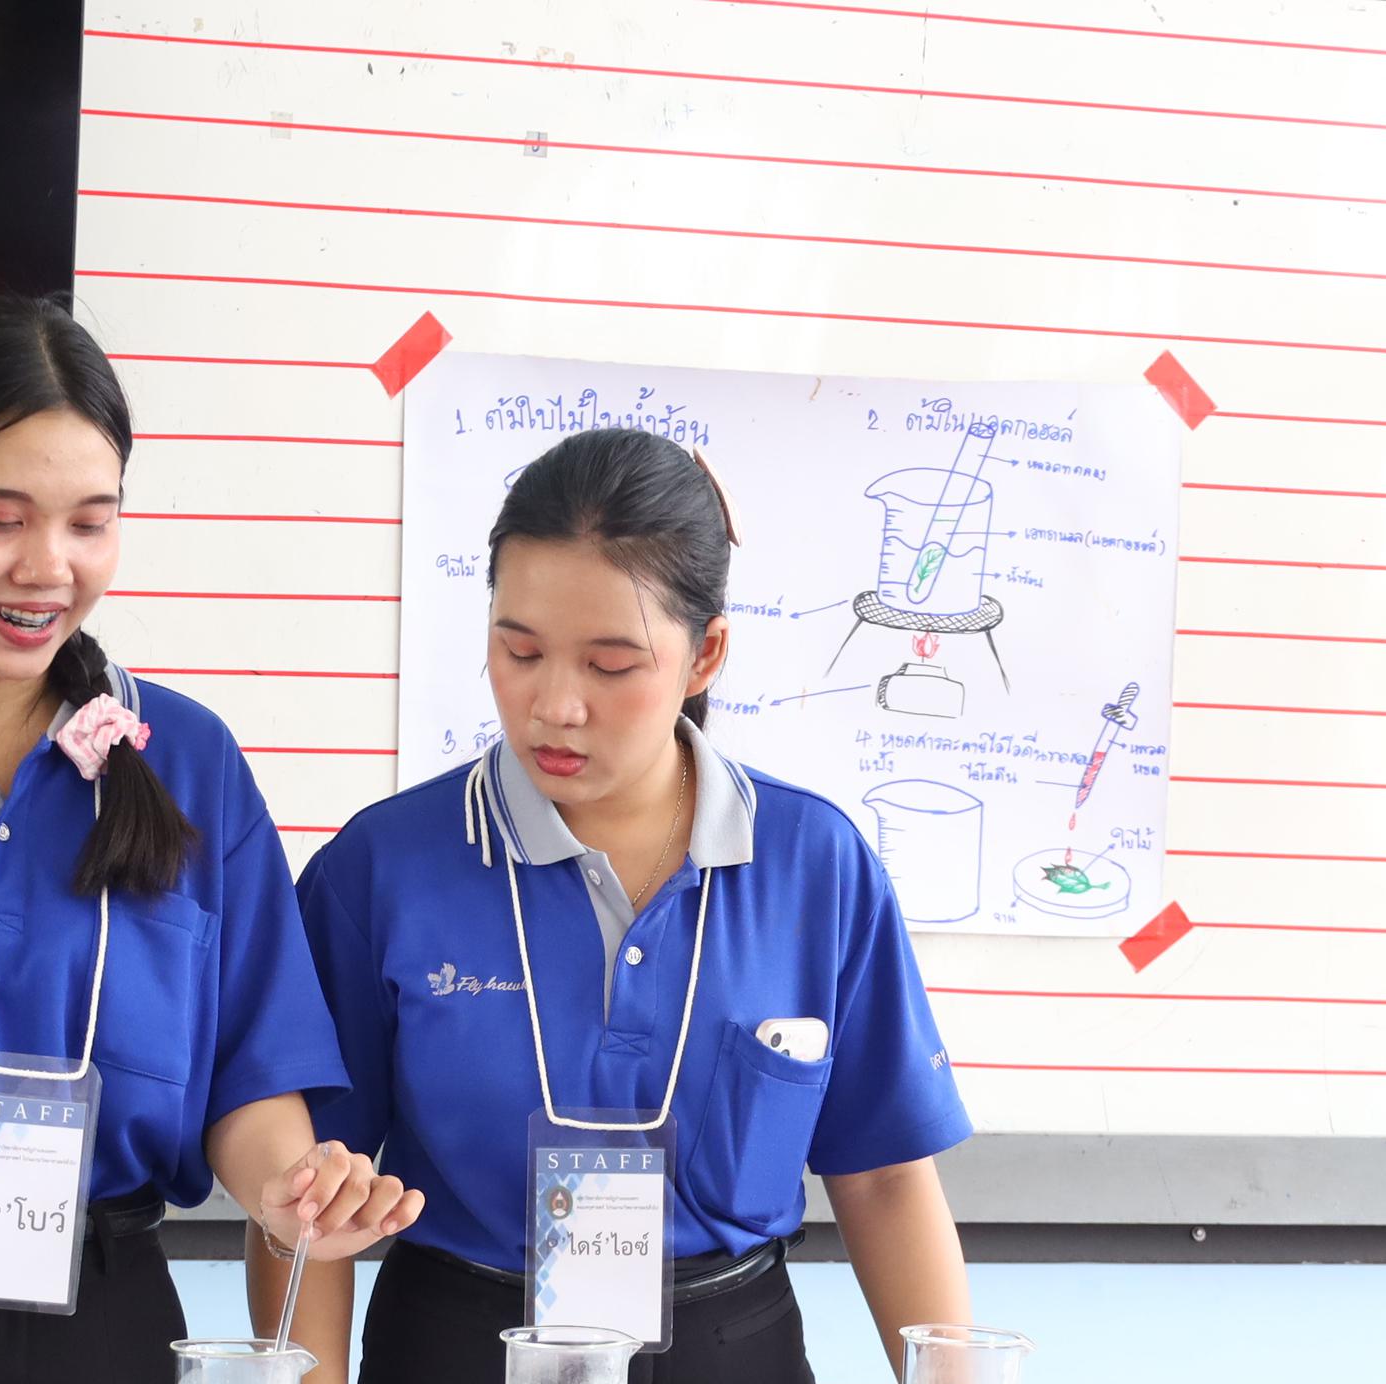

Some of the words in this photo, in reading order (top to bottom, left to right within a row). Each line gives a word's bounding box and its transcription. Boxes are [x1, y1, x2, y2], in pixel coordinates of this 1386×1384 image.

[435, 553, 480, 578] ใบไม้
[1110, 827, 1156, 851] ใบไม้
[547, 1152, 654, 1171] STAFF
